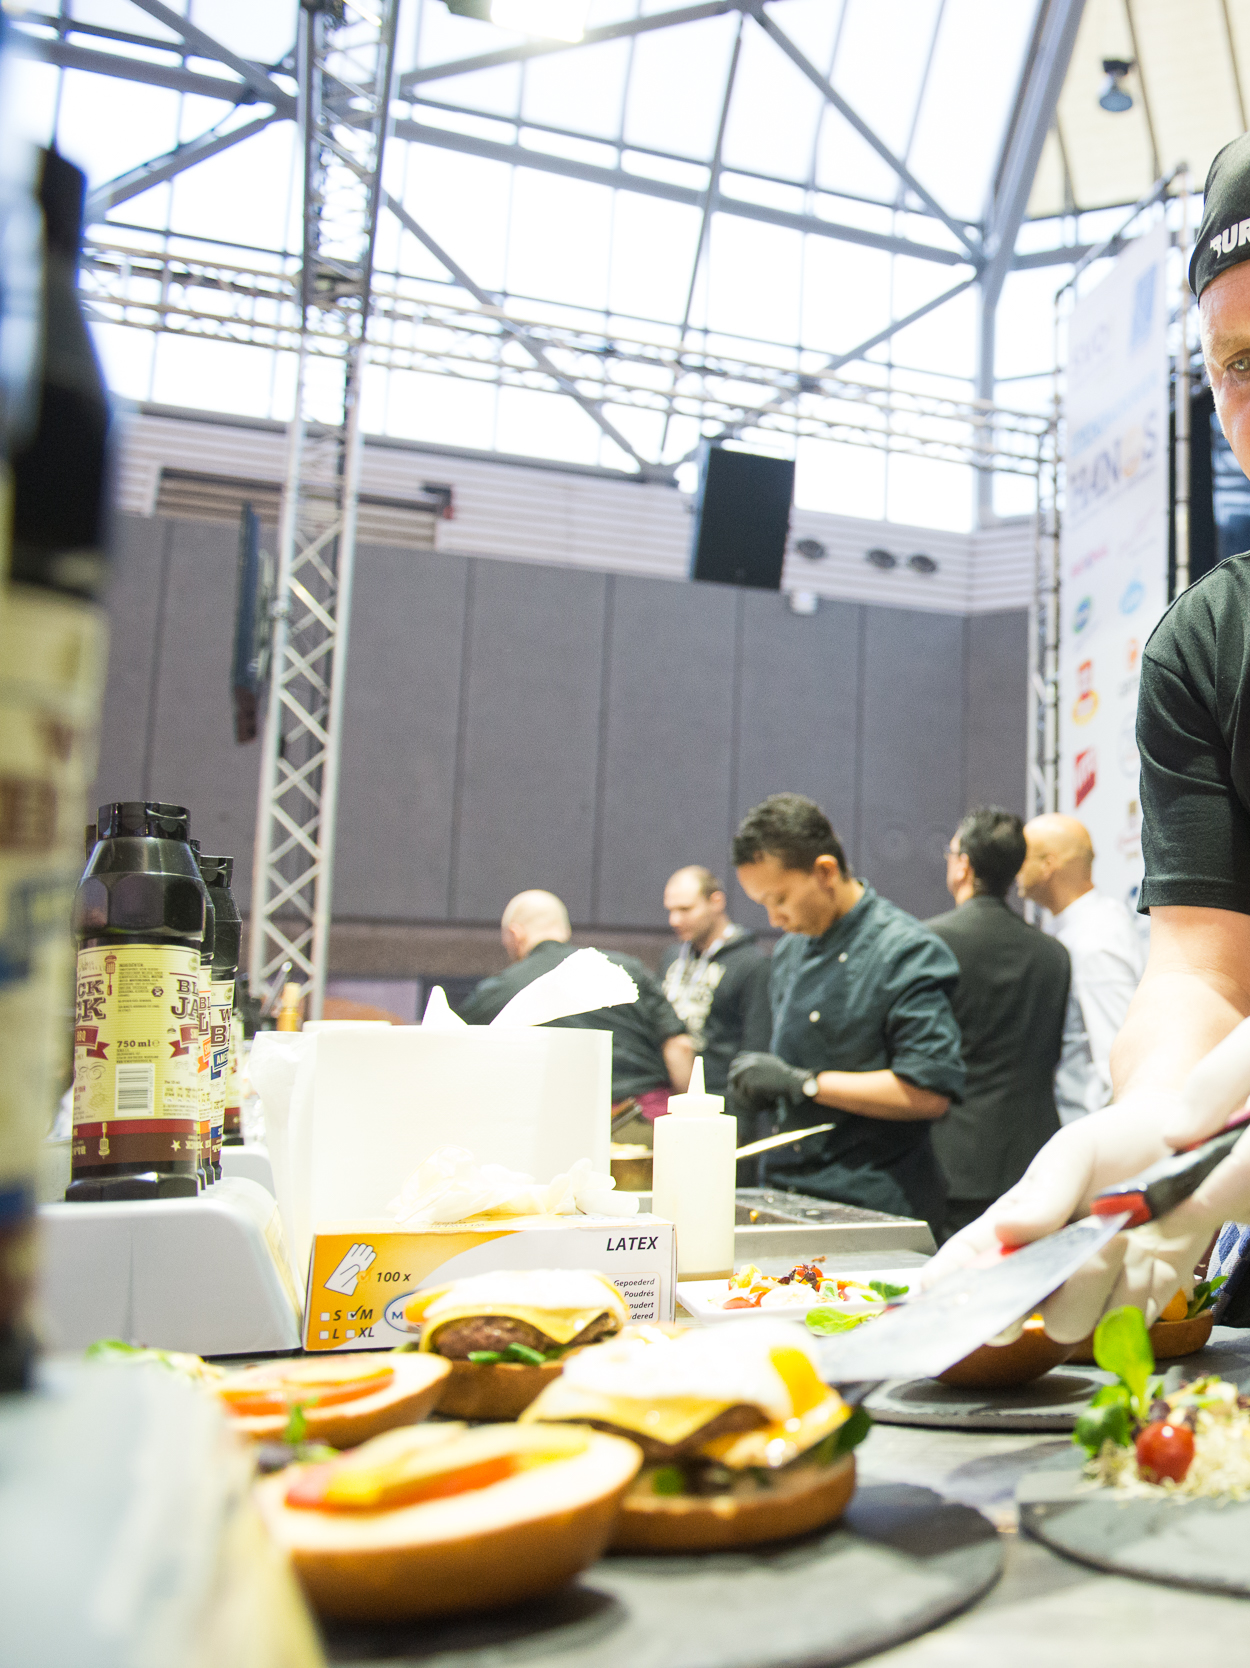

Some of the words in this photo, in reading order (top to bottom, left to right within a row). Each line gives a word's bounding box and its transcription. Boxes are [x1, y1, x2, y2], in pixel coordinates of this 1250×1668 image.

[117, 1040, 137, 1048] 750
[138, 1039, 151, 1047] ml
[606, 1236, 658, 1251] LATEX
[377, 1271, 400, 1282] 100
[403, 1273, 411, 1282] x
[614, 1279, 655, 1288] Gepoederd
[624, 1290, 654, 1298] Poudrés
[629, 1301, 654, 1310] pudert
[333, 1310, 342, 1321] S
[360, 1309, 373, 1320] M
[631, 1312, 654, 1320] dered
[332, 1329, 339, 1339] L
[358, 1327, 374, 1338] XL
